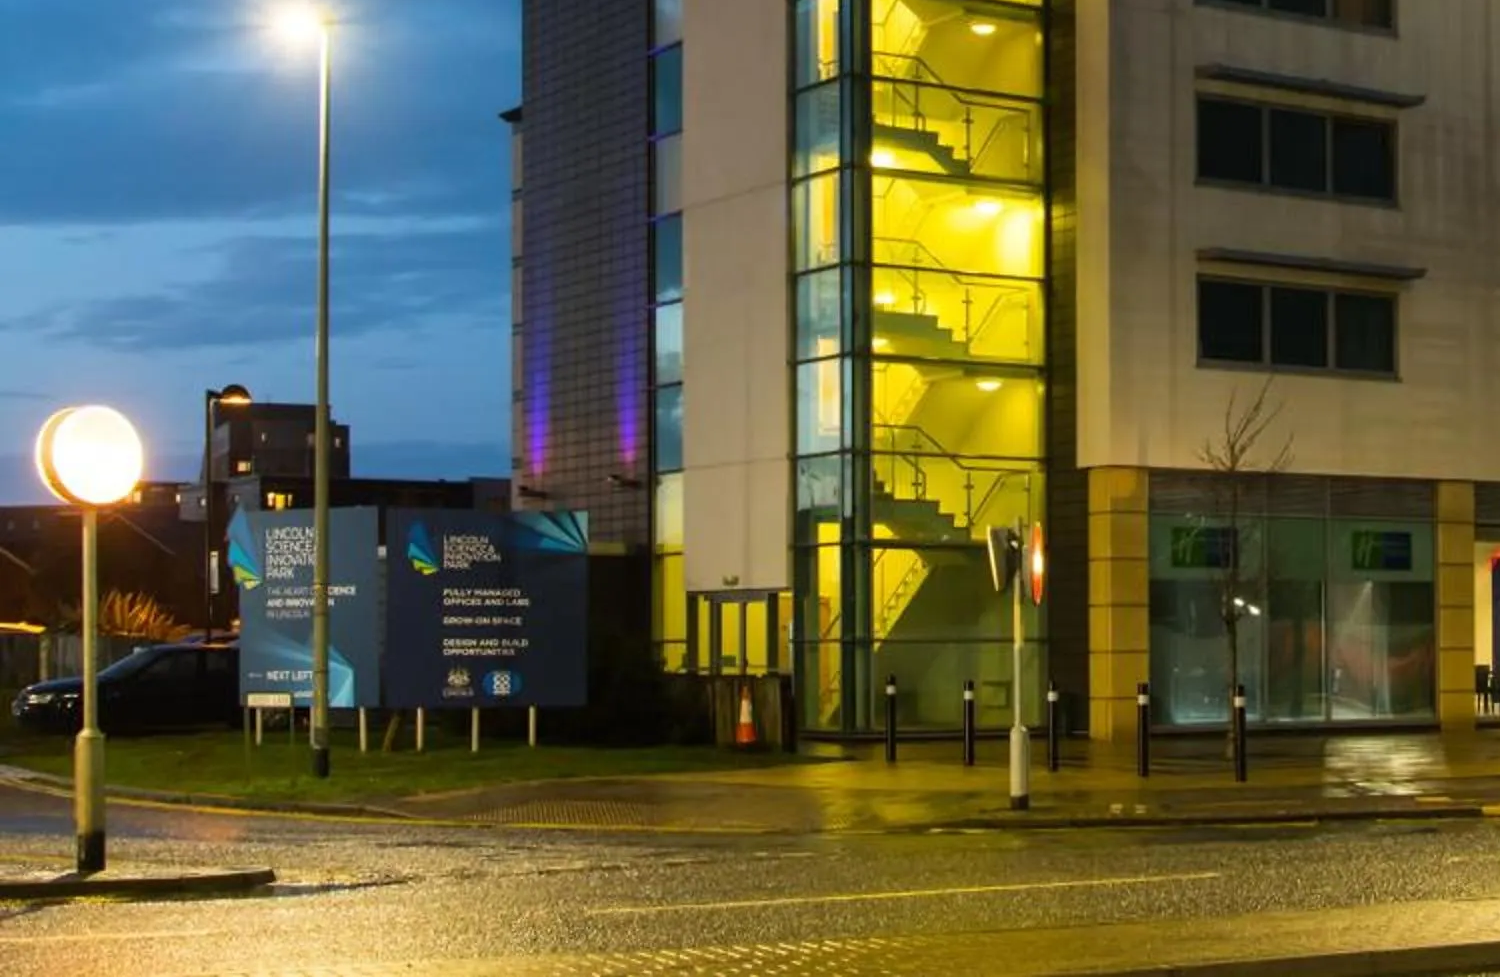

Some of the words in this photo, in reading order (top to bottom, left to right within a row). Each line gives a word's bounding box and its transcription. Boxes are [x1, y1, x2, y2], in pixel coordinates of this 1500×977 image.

[443, 534, 489, 544] LINCOLN
[443, 552, 502, 562] INNOVATION
[443, 561, 470, 571] PARK
[265, 566, 295, 580] PARK
[328, 586, 356, 596] CIENCE
[443, 588, 473, 597] FULLY
[474, 589, 521, 597] MANAGED
[266, 598, 283, 608] AND
[443, 598, 482, 607] OFFICES
[484, 598, 505, 607] AND
[506, 598, 530, 607] LABS
[492, 616, 522, 626] SPACE
[443, 638, 477, 647] DESIGN
[479, 638, 499, 647] AND
[501, 638, 529, 648] BUILD
[443, 648, 516, 657] OPPORTUNITIES
[266, 670, 290, 681] NEXT
[291, 670, 314, 681] LEFT
